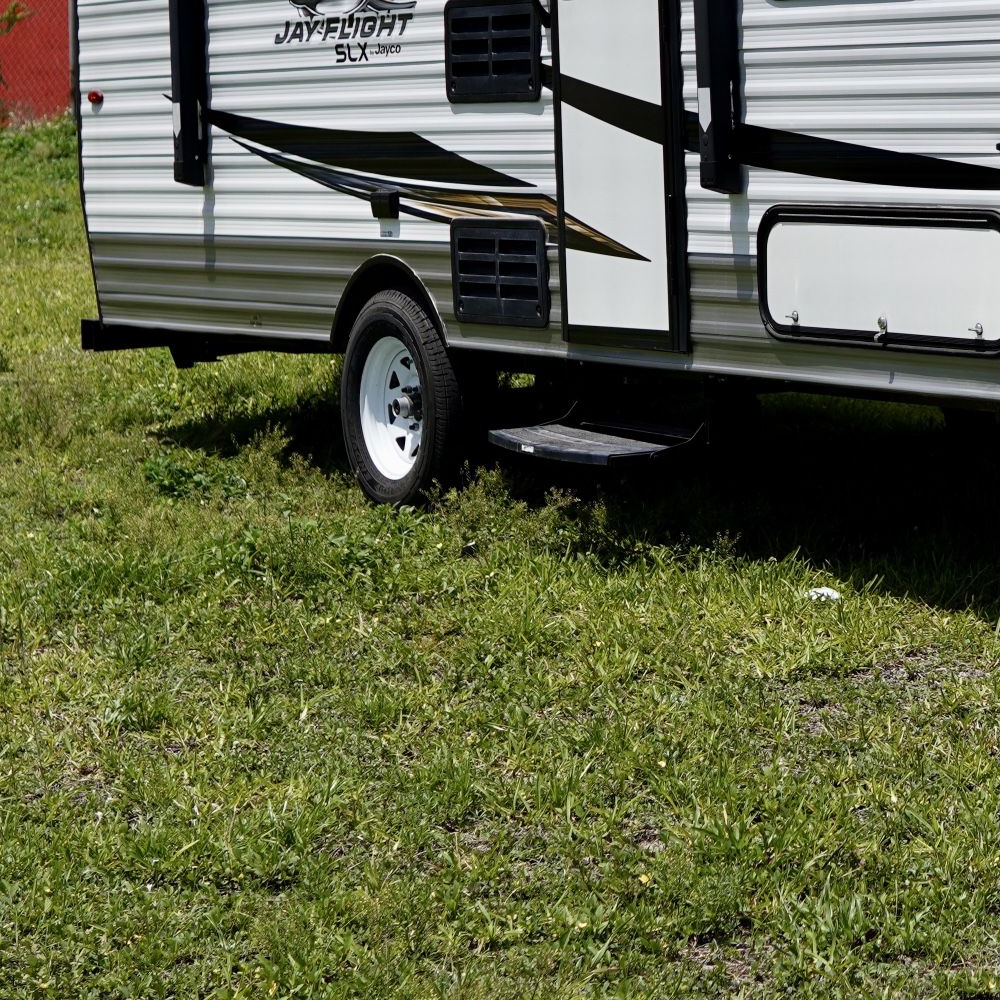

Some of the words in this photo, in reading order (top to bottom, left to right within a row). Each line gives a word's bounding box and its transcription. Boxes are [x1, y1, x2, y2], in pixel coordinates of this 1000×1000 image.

[274, 20, 320, 44] JAY
[321, 13, 413, 41] FLIGHT
[335, 42, 369, 63] SLX
[375, 43, 402, 56] Jayco
